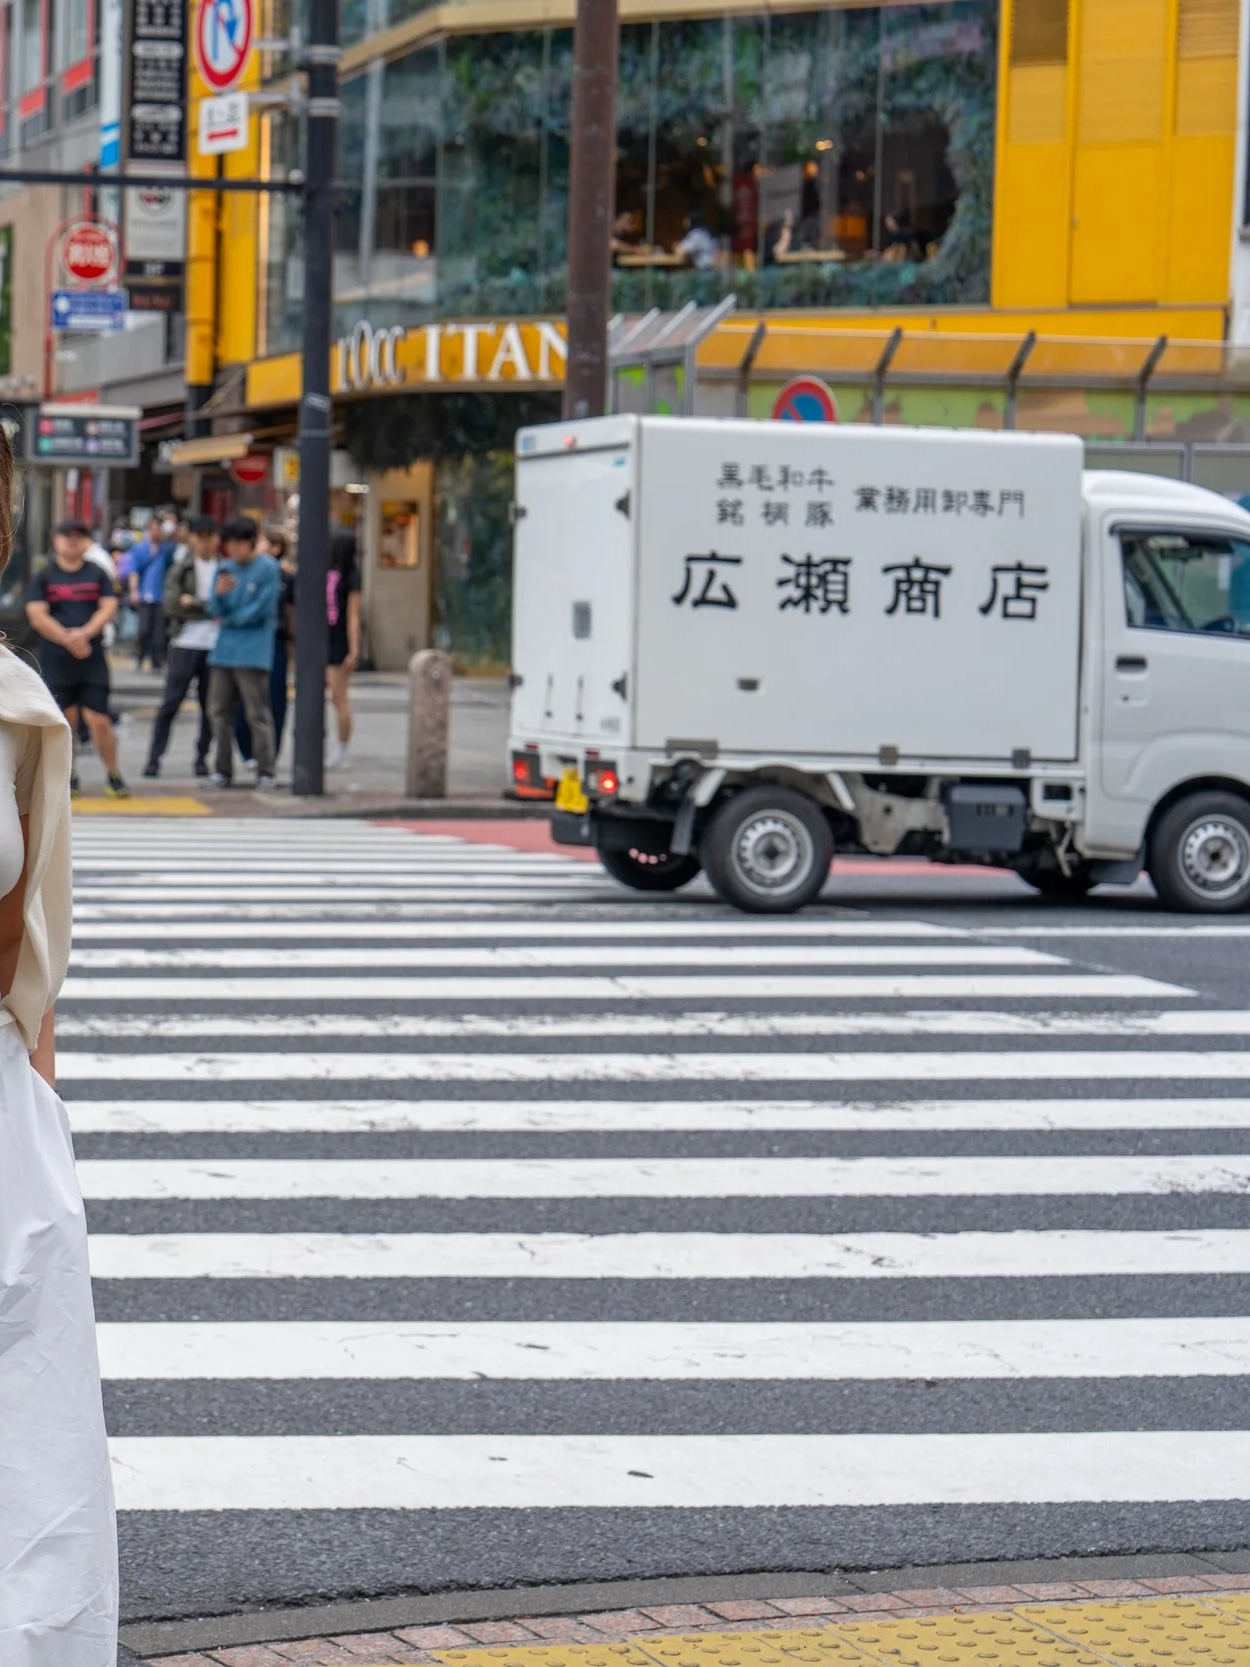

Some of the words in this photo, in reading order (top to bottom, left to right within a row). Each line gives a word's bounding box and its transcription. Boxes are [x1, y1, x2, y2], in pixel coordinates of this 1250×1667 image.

[716, 461, 834, 492] 黒毛和牛
[715, 497, 834, 528] 銘柄豚
[853, 483, 1026, 519] 業務用卸専門
[671, 549, 1050, 621] 広瀬商店
